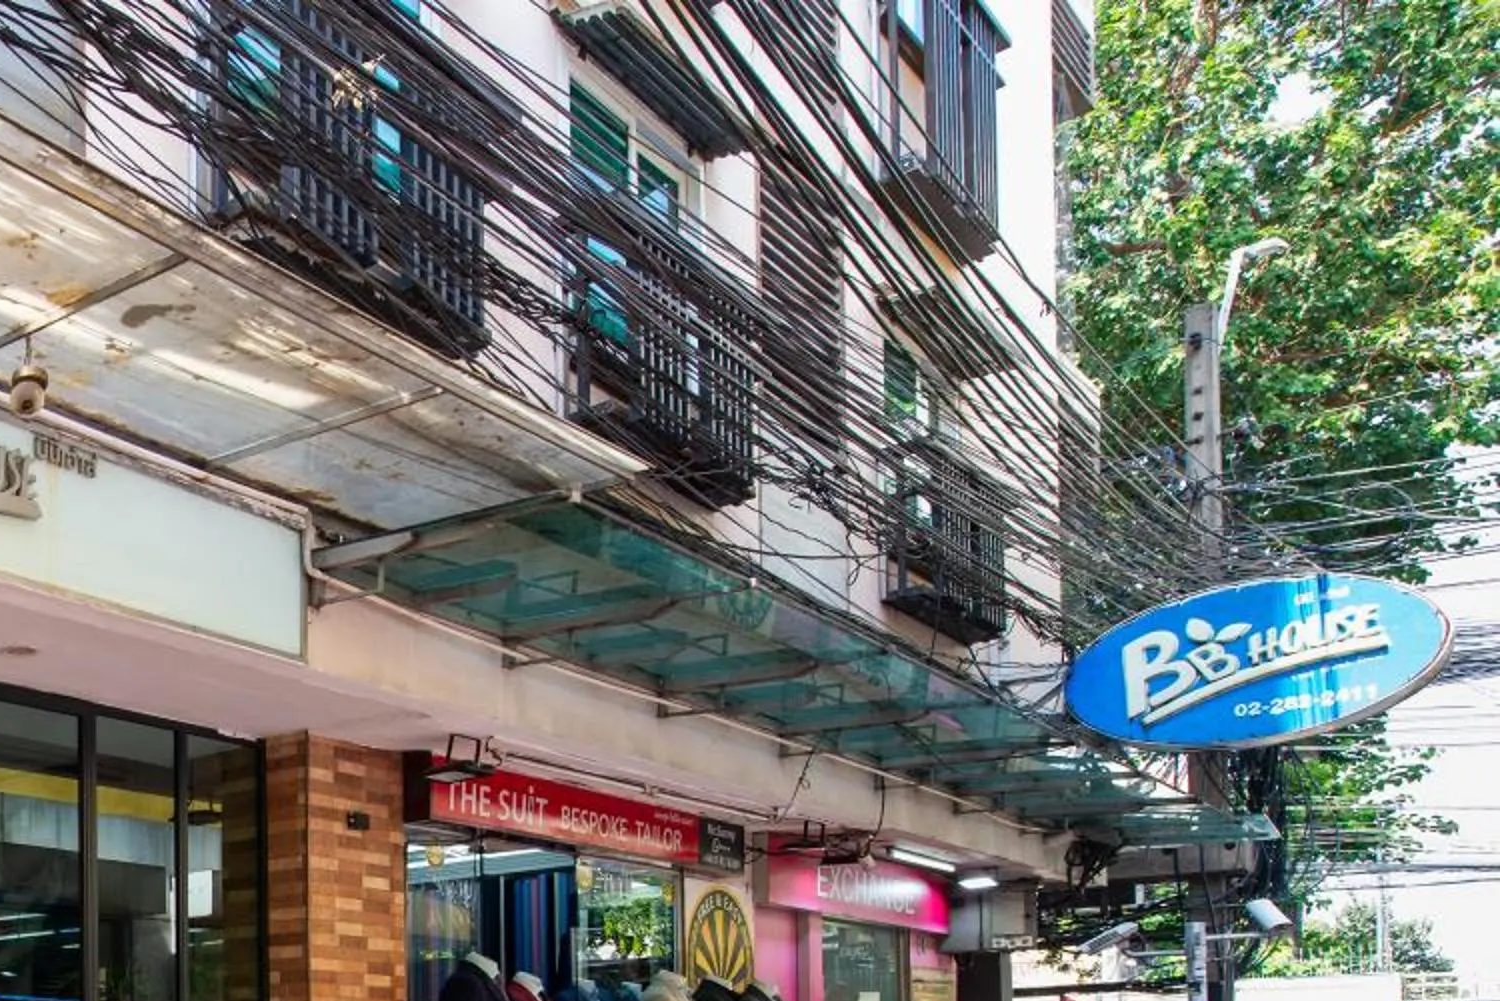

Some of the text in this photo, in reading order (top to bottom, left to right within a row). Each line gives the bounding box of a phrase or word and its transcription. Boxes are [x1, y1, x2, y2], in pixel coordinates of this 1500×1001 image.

[1247, 603, 1380, 666] HOUSE
[448, 781, 491, 818] THE
[560, 804, 629, 842] BESPOKE
[635, 820, 684, 852] TAILOR
